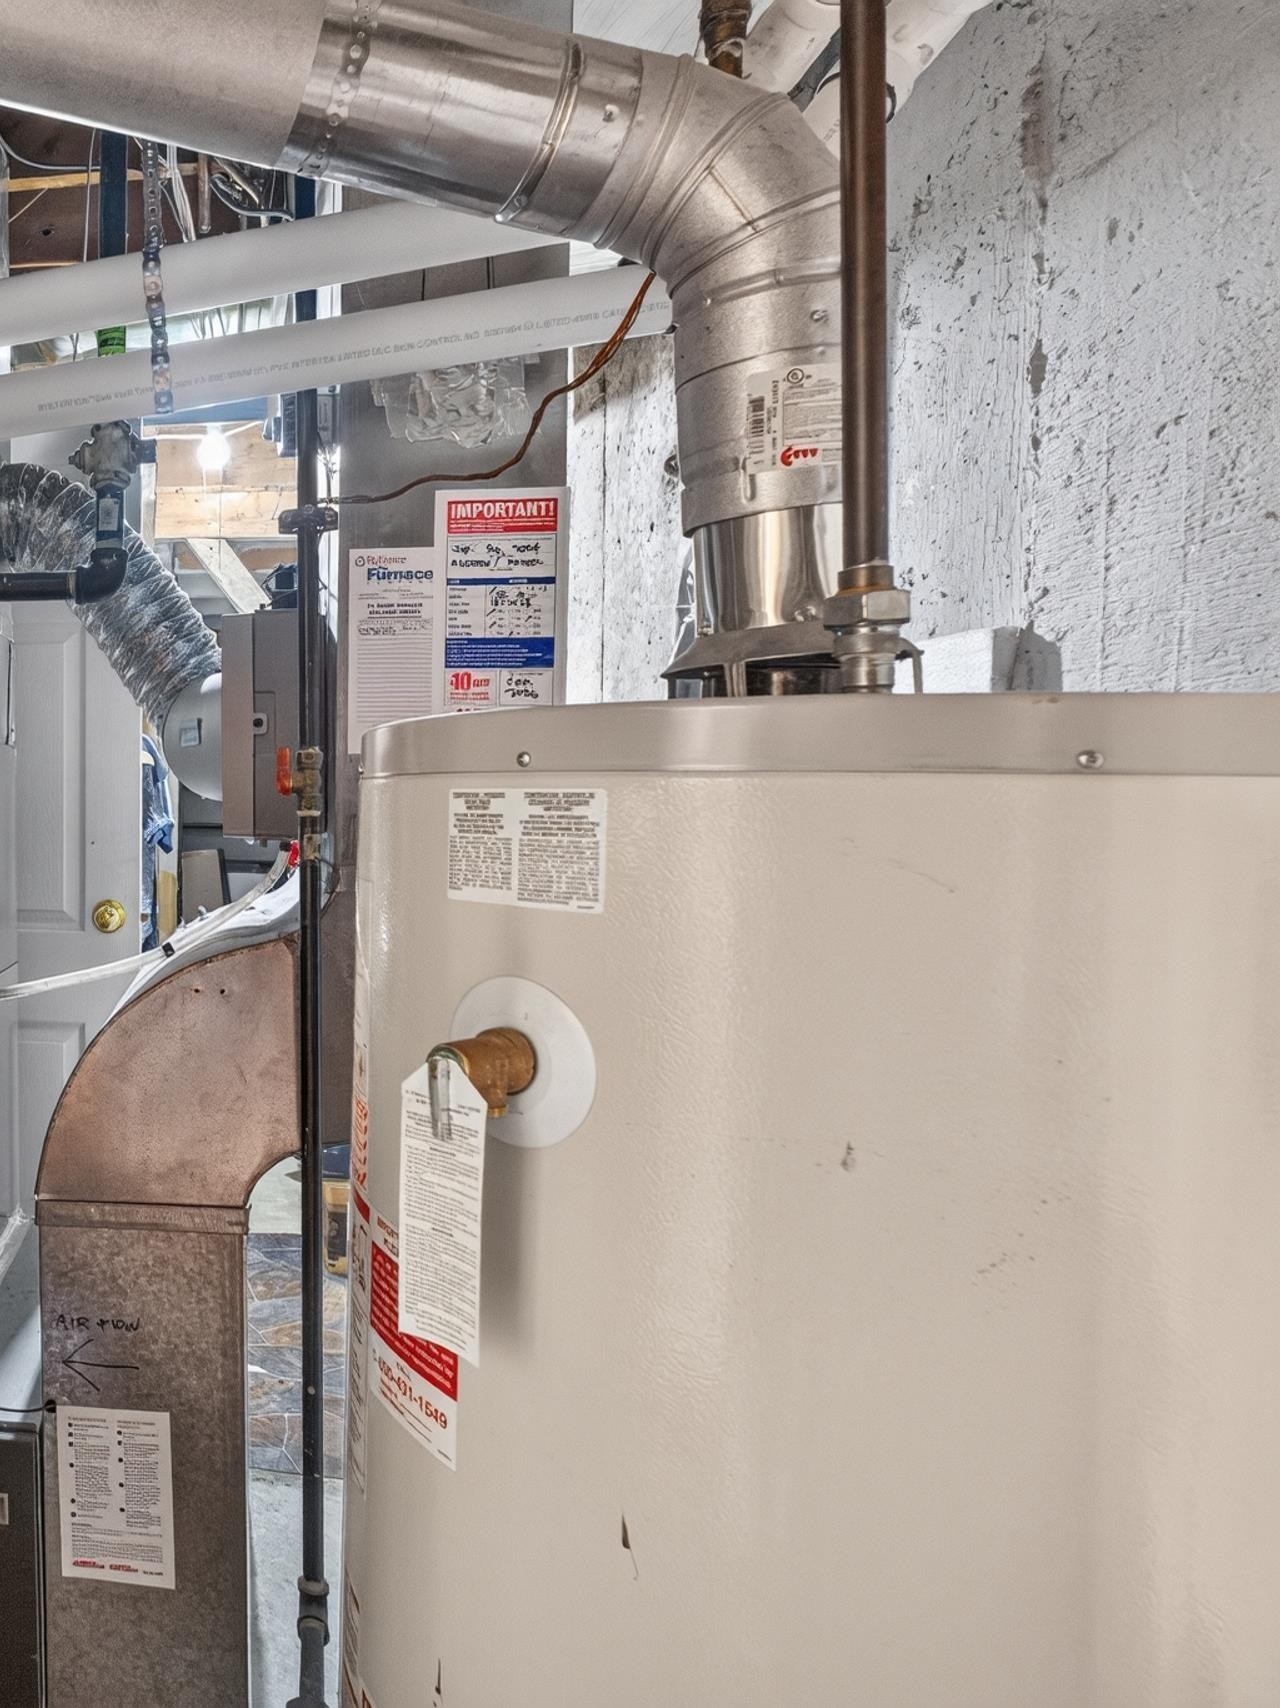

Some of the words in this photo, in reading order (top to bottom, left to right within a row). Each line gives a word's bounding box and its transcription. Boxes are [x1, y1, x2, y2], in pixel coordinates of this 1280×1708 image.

[450, 501, 556, 519] IMPORTANT!
[367, 567, 434, 581] Furnace
[56, 1313, 90, 1331] AIR
